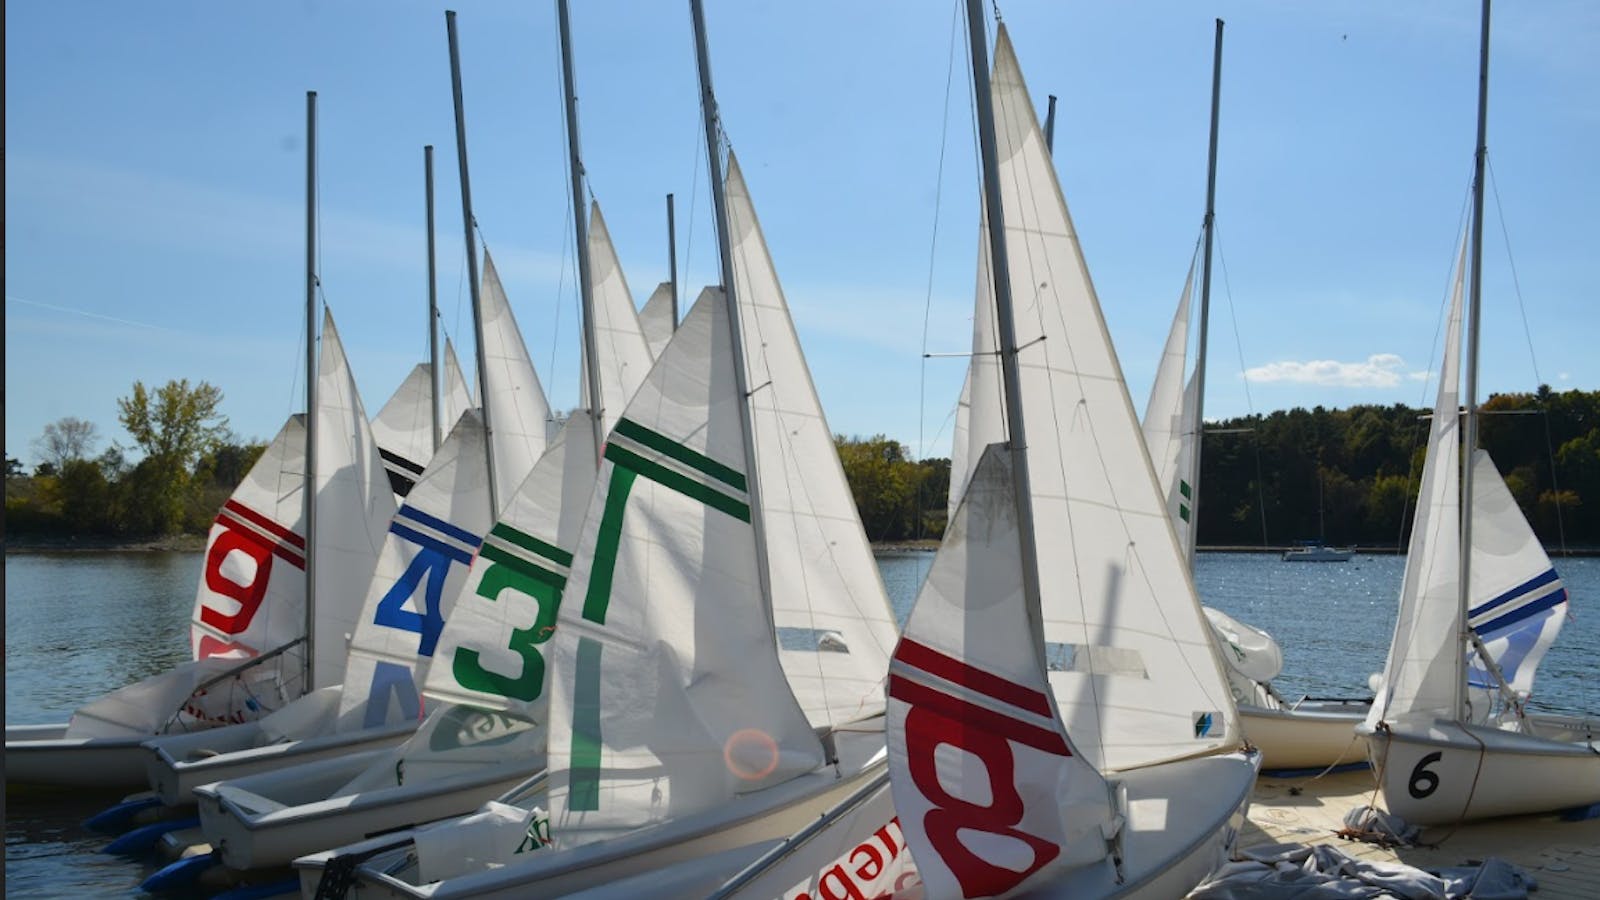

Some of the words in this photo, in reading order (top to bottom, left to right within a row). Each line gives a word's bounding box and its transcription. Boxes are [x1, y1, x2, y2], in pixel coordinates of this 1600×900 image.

[201, 529, 273, 635] 9
[373, 546, 453, 657] 4
[453, 562, 563, 702] 3
[905, 704, 1061, 899] 8
[1408, 751, 1442, 800] 6
